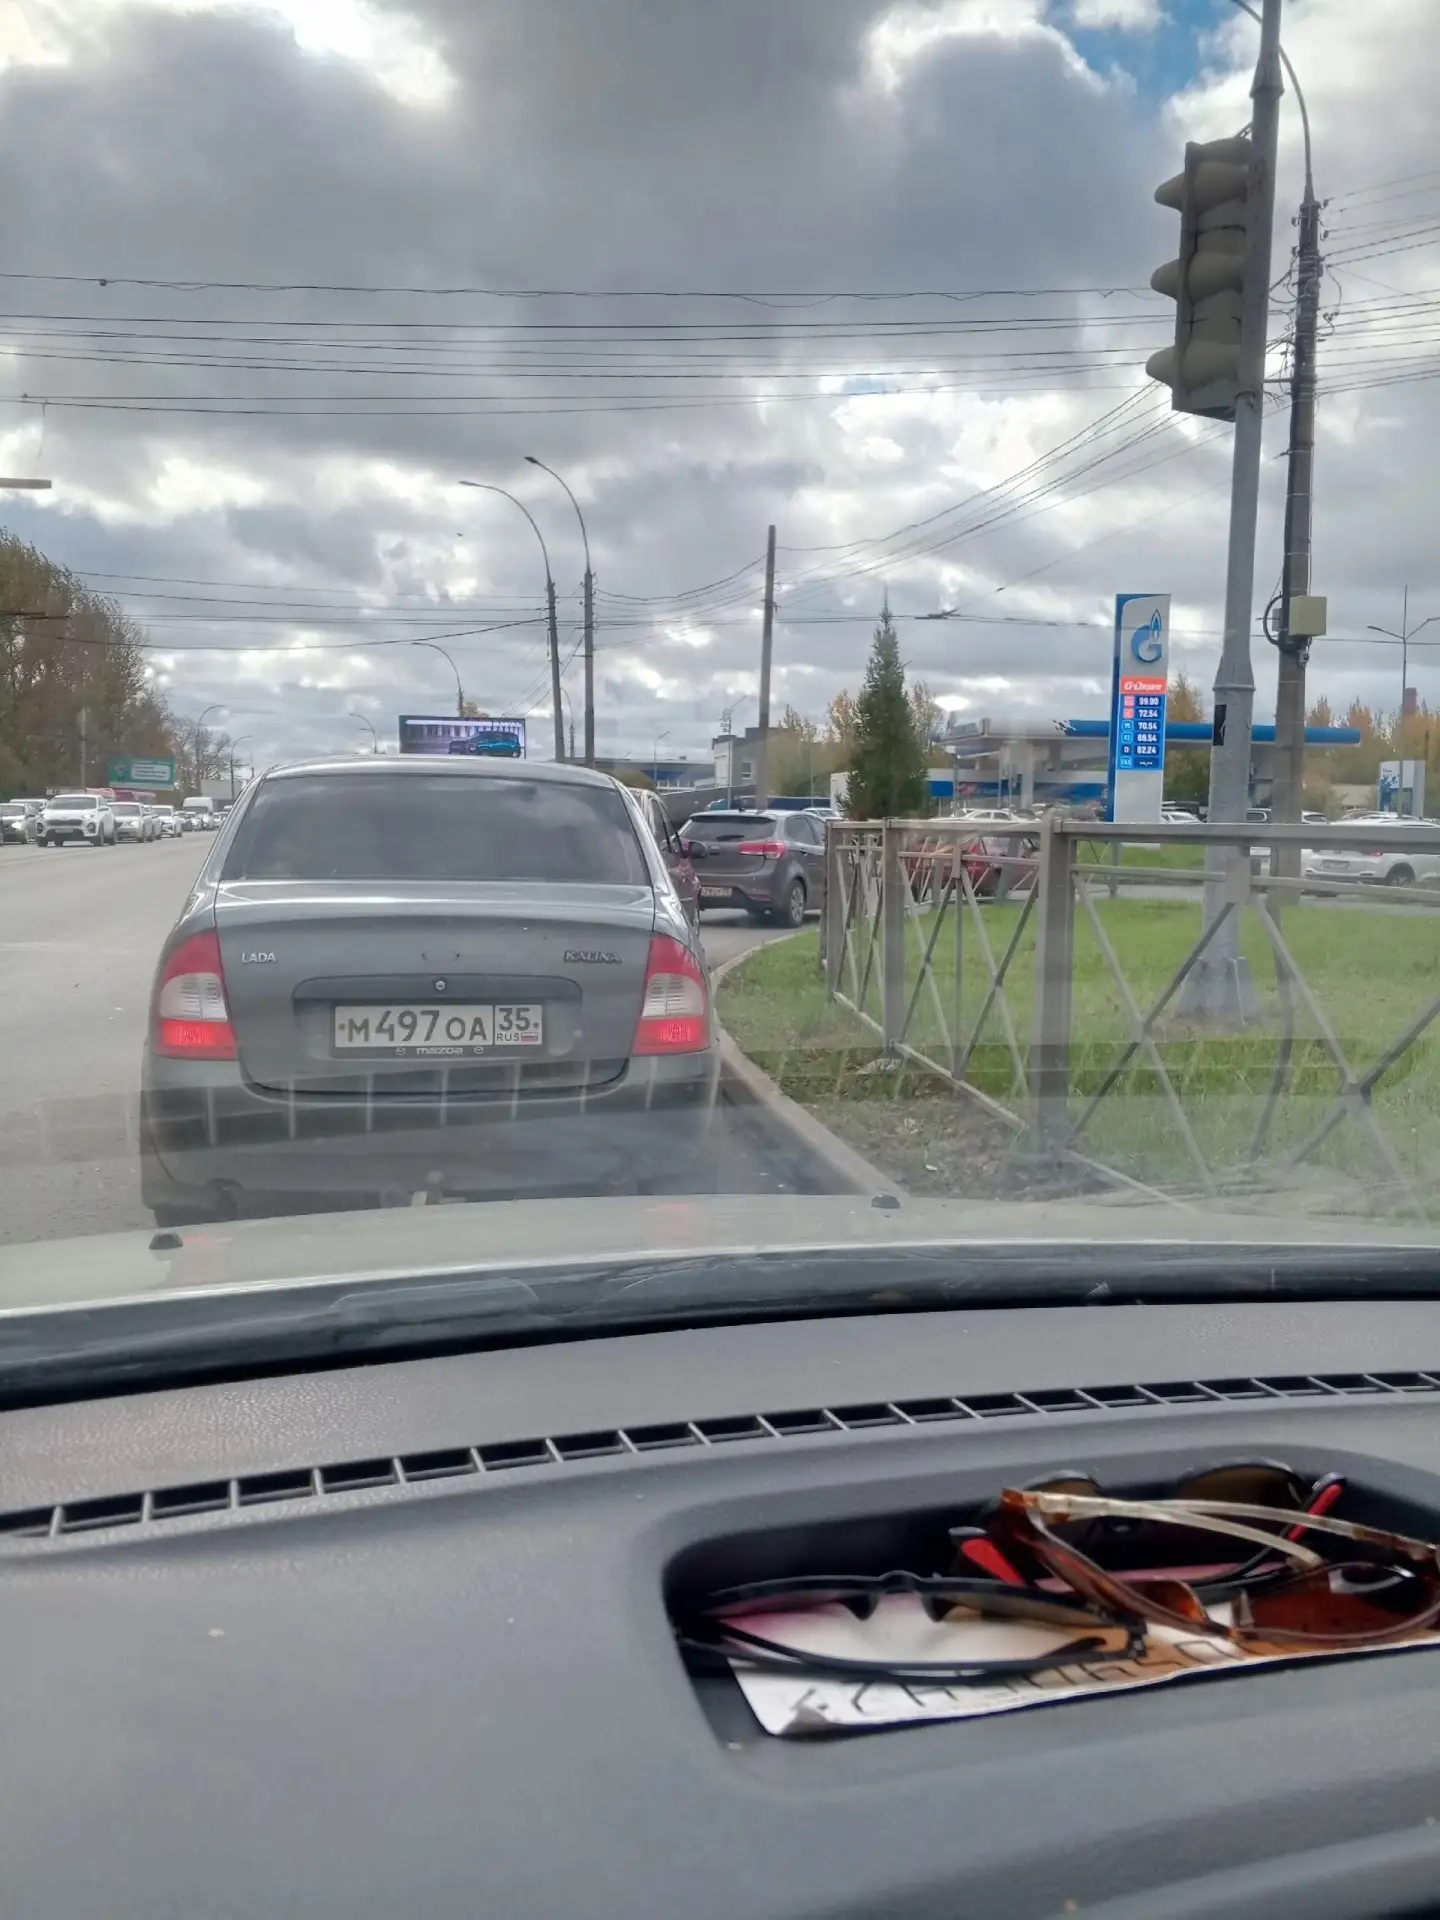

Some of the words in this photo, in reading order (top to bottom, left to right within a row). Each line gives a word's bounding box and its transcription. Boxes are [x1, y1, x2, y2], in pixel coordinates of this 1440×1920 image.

[1138, 709, 1159, 718] 72.54
[1137, 721, 1158, 730] 70.54
[241, 952, 276, 963] LADA
[563, 950, 622, 963] KALINA
[498, 1007, 531, 1031] 35
[496, 1033, 520, 1042] RUS
